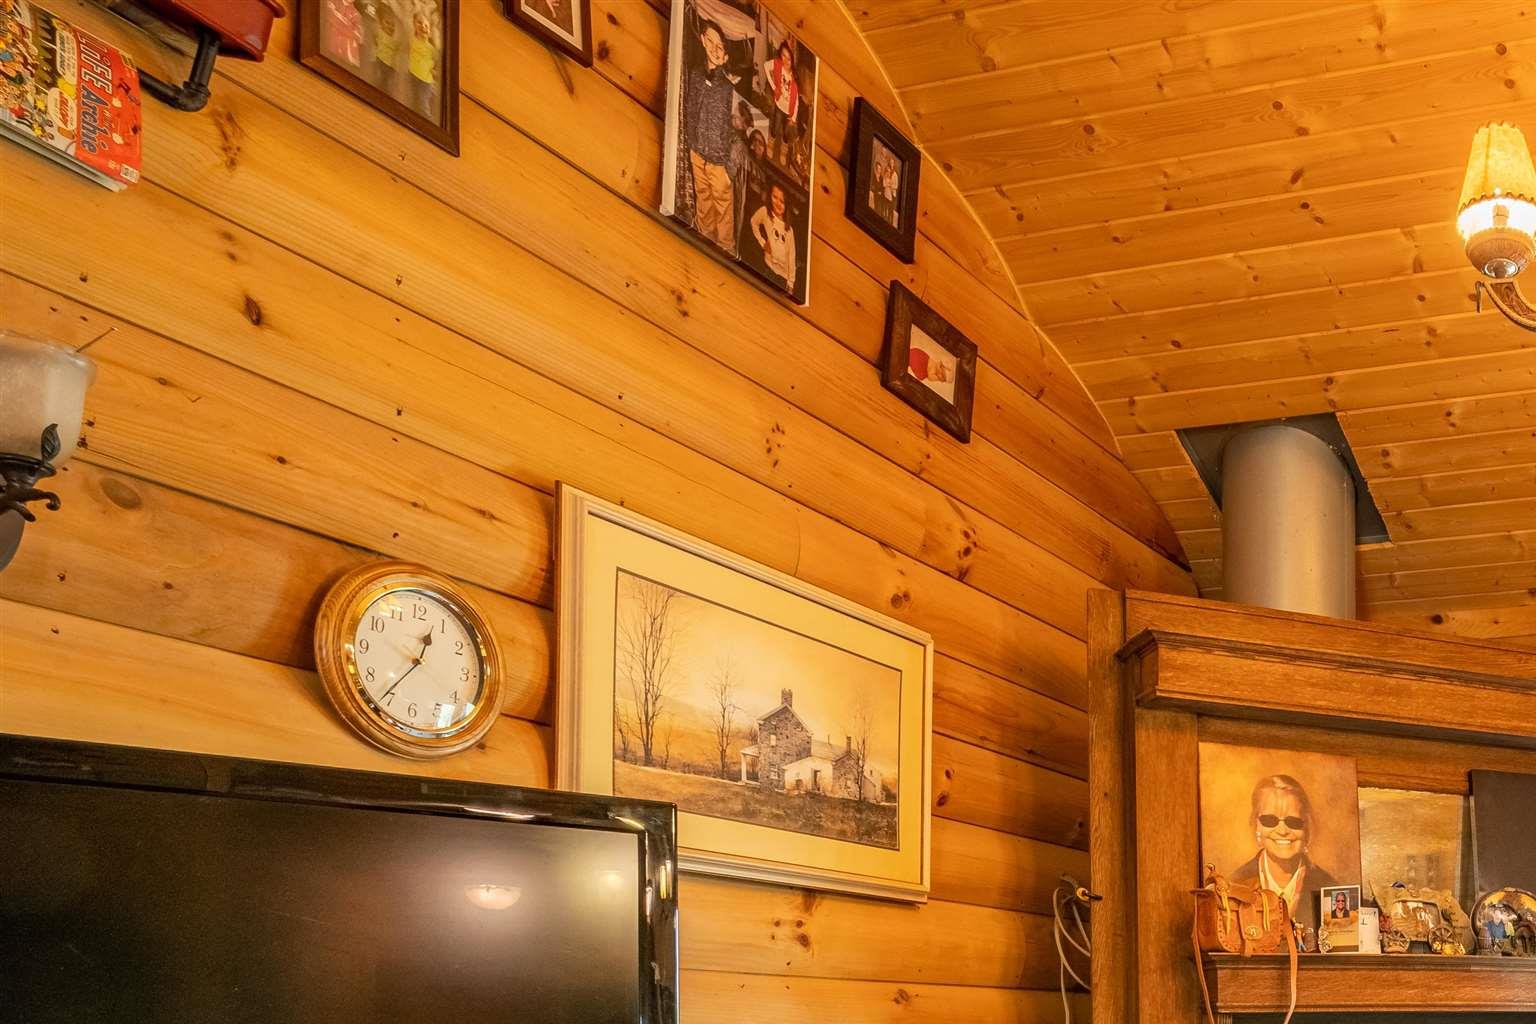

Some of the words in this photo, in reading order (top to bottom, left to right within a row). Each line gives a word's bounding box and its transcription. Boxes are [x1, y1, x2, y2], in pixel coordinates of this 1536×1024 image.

[412, 603, 427, 621] 12
[371, 616, 385, 633] 10
[440, 619, 446, 634] 1
[359, 639, 369, 654] 9
[455, 641, 464, 655] 2
[366, 667, 375, 683] 8
[460, 667, 470, 682] 3
[450, 690, 460, 704] 4
[408, 703, 417, 718] 6
